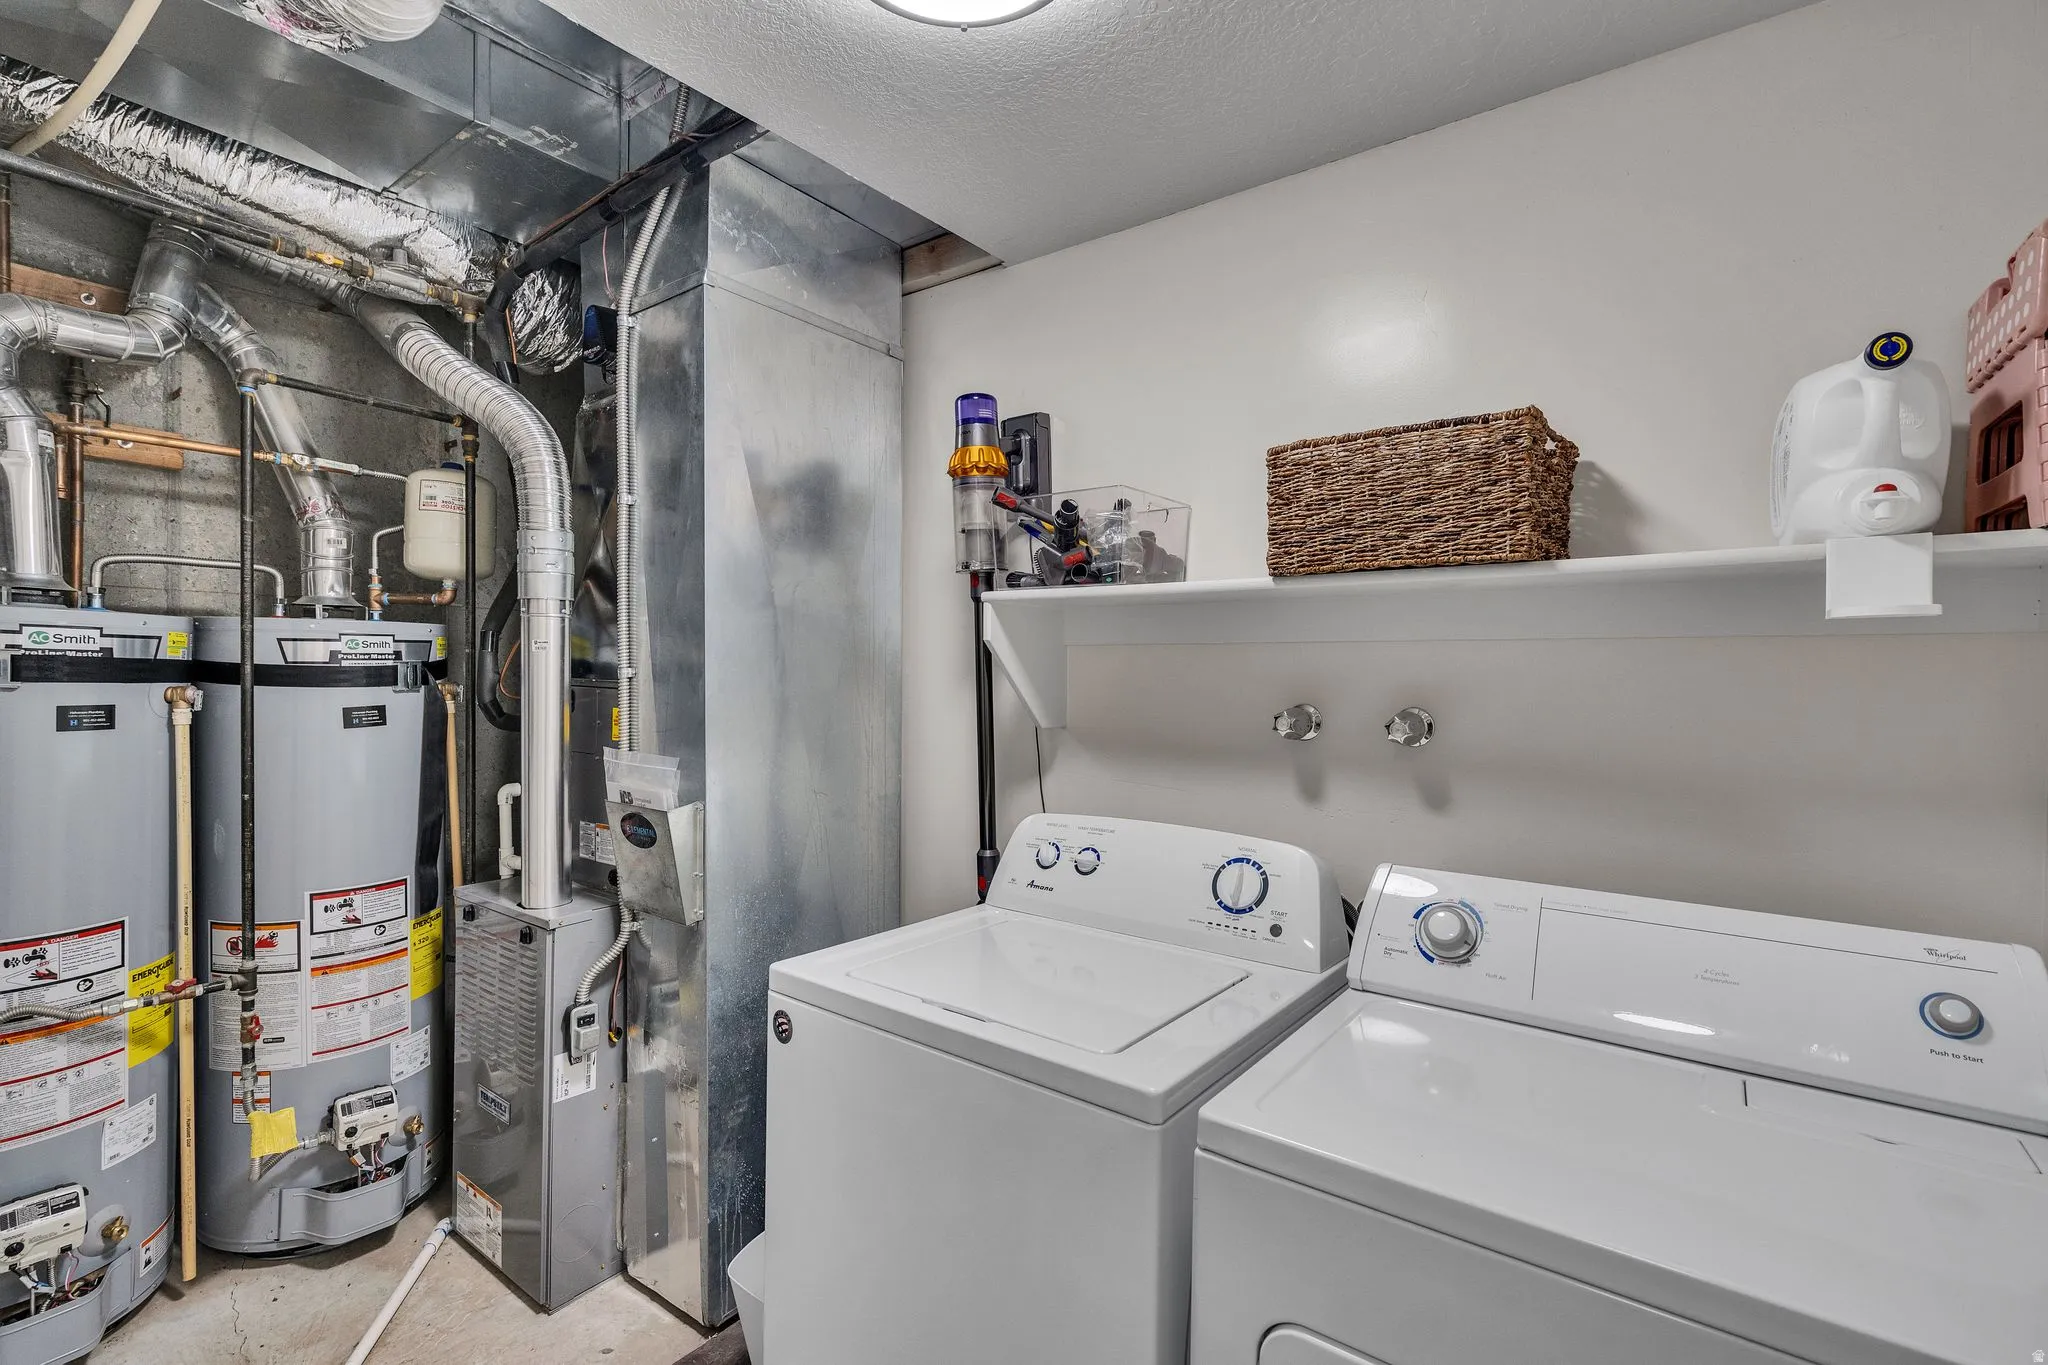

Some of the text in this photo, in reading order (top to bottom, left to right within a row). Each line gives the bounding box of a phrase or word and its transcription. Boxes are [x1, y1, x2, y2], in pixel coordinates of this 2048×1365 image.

[53, 633, 96, 645] Smith
[361, 640, 391, 649] Smith
[1026, 880, 1054, 891] Amana
[1930, 1048, 1984, 1064] Push to Start
